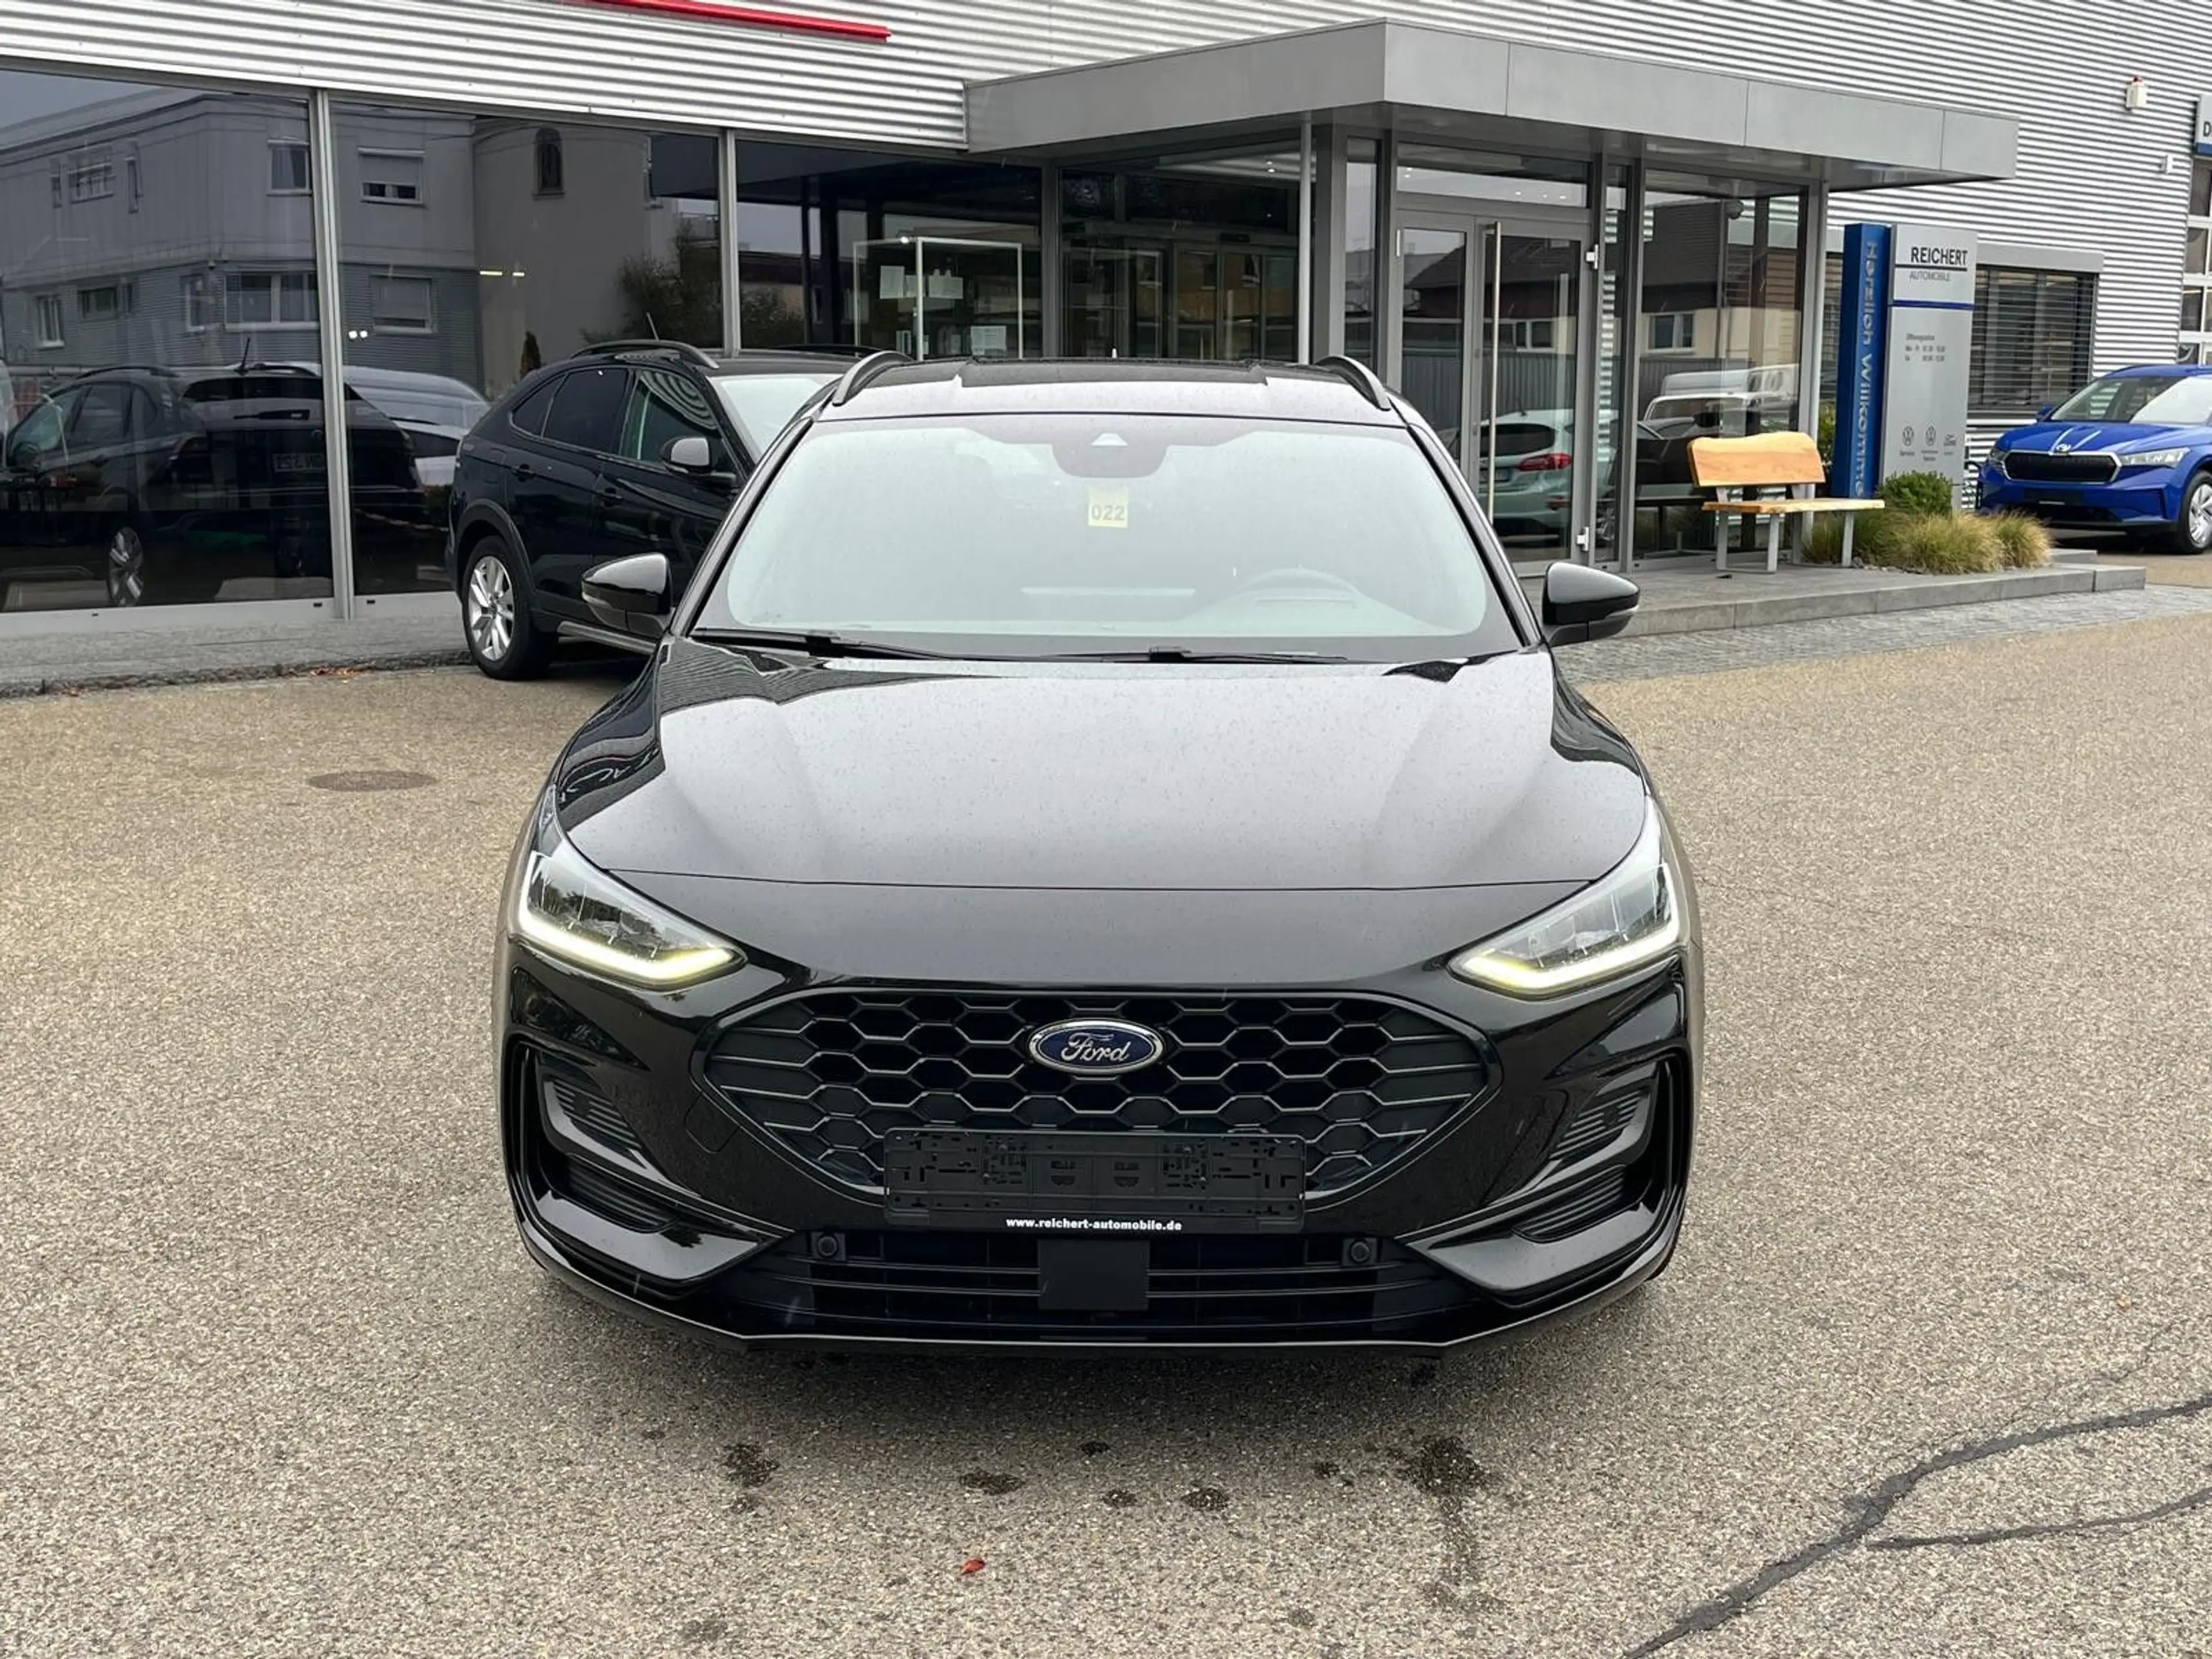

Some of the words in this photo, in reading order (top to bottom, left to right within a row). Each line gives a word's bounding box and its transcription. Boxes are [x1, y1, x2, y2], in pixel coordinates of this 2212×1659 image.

[1911, 247, 1968, 265] REICHERT
[1863, 243, 1877, 345] Herzlich
[1855, 354, 1872, 498] Willkomme
[1092, 504, 1125, 521] 022
[1060, 1032, 1131, 1061] Ford
[1006, 1218, 1182, 1230] www.reichert-automobile.de
